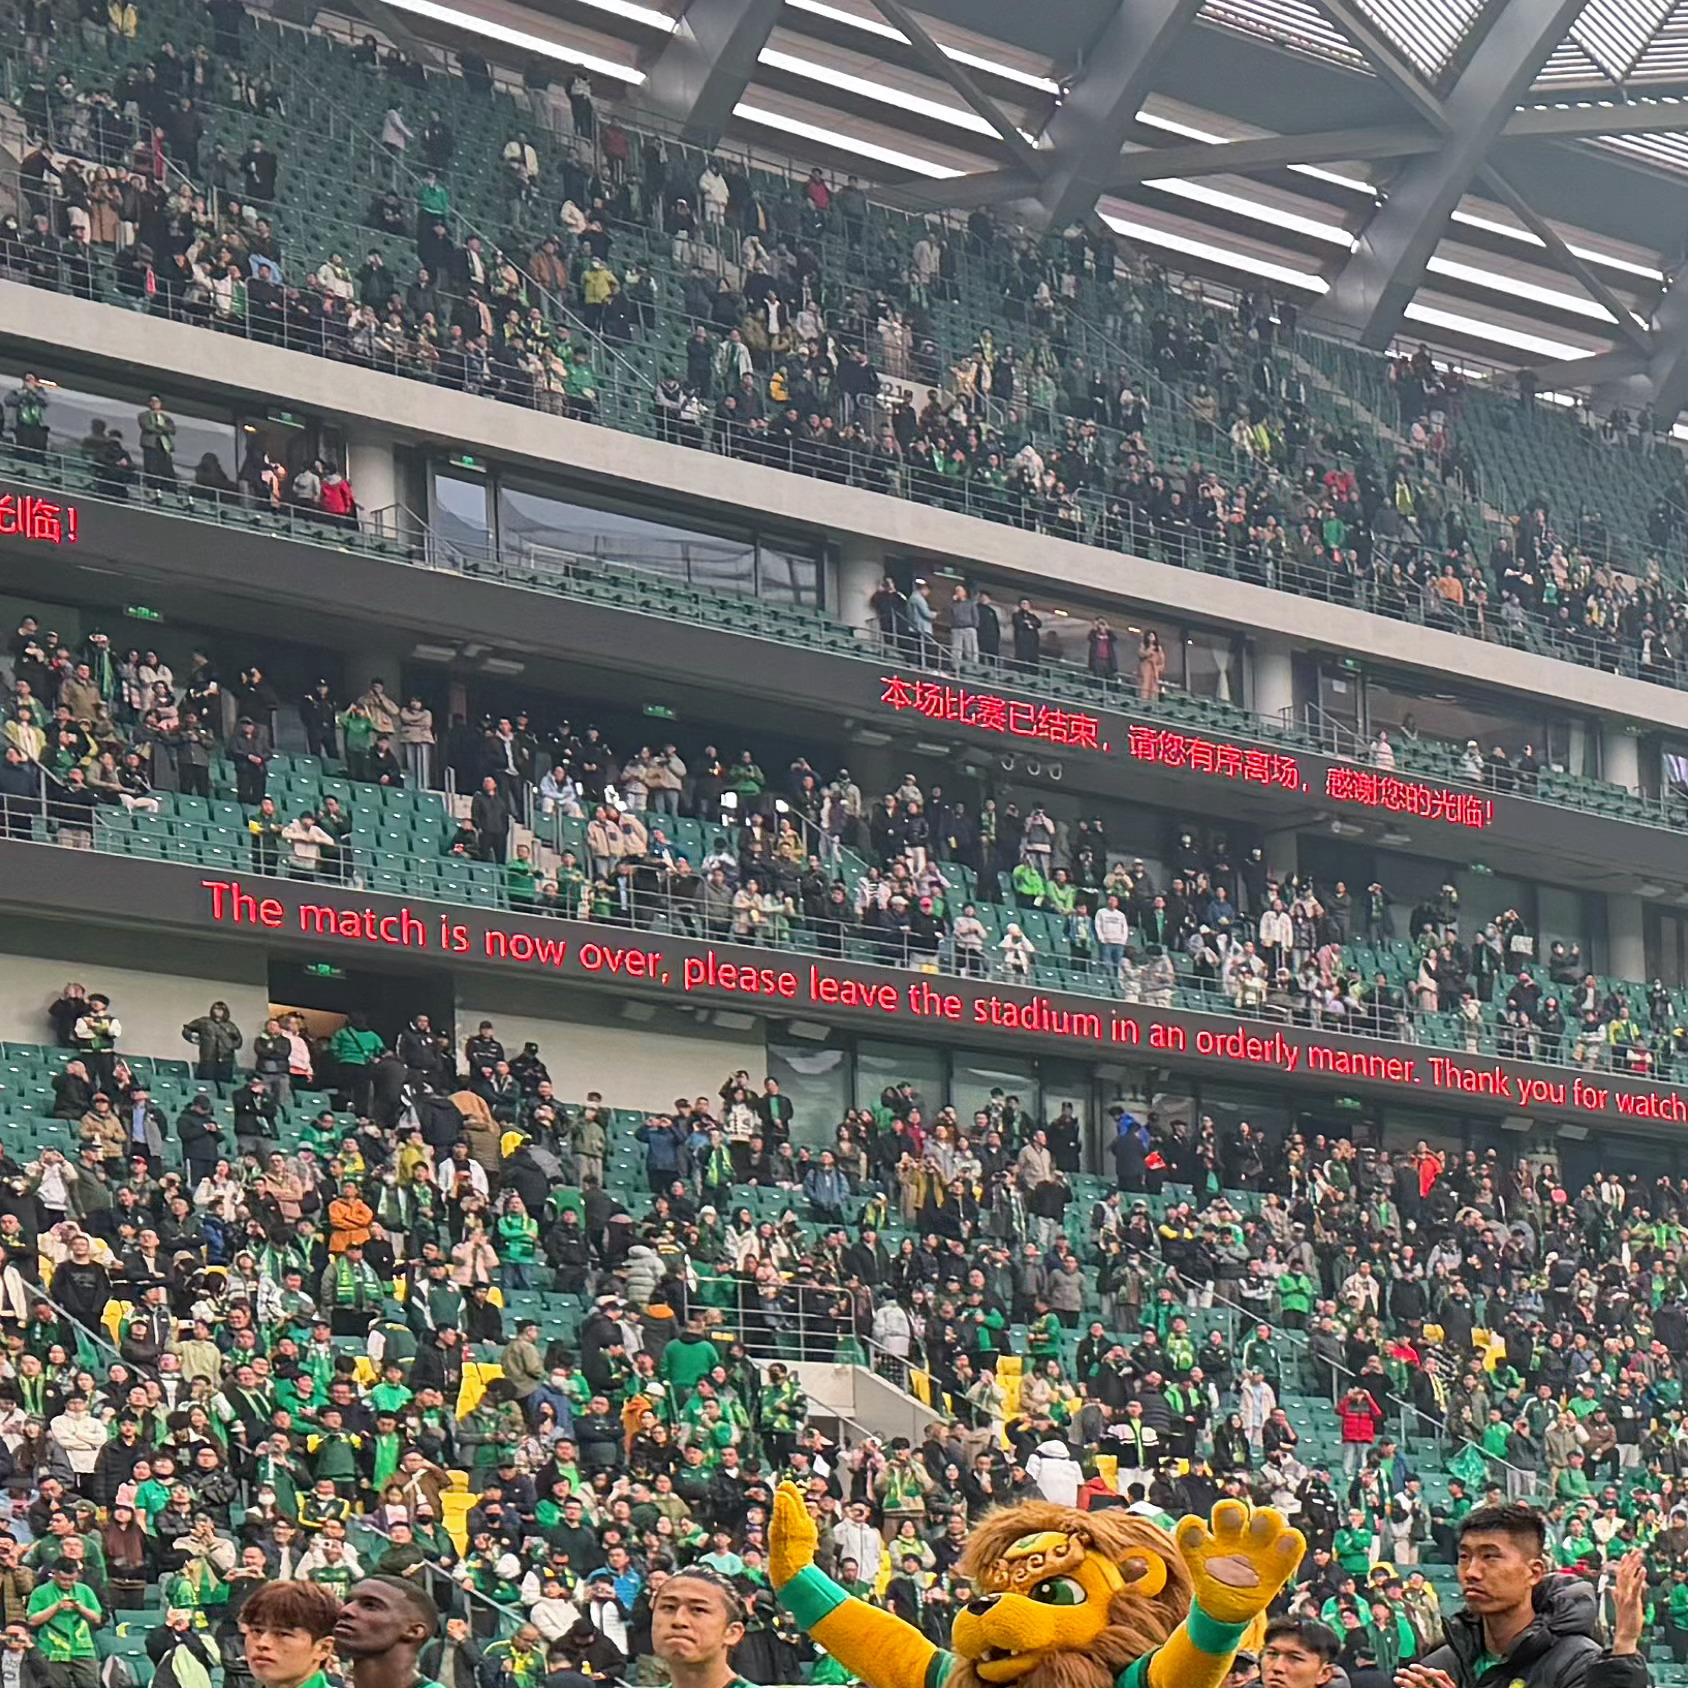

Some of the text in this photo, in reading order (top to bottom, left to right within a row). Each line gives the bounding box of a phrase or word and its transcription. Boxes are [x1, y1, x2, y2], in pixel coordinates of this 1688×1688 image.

[202, 880, 286, 928] The
[300, 905, 428, 948] match
[441, 915, 472, 954] is
[486, 931, 568, 968] now
[579, 944, 670, 984] over,
[684, 952, 800, 998] please
[810, 966, 899, 1014] leave
[908, 982, 964, 1022] the
[974, 996, 1103, 1042] stadium
[1111, 1009, 1140, 1046] in
[1150, 1024, 1187, 1054] an
[1196, 1028, 1300, 1072] orderly
[1308, 1046, 1421, 1085] manner.
[1428, 1056, 1511, 1100] Thank
[1517, 1078, 1567, 1108] you
[1573, 1077, 1608, 1112] for
